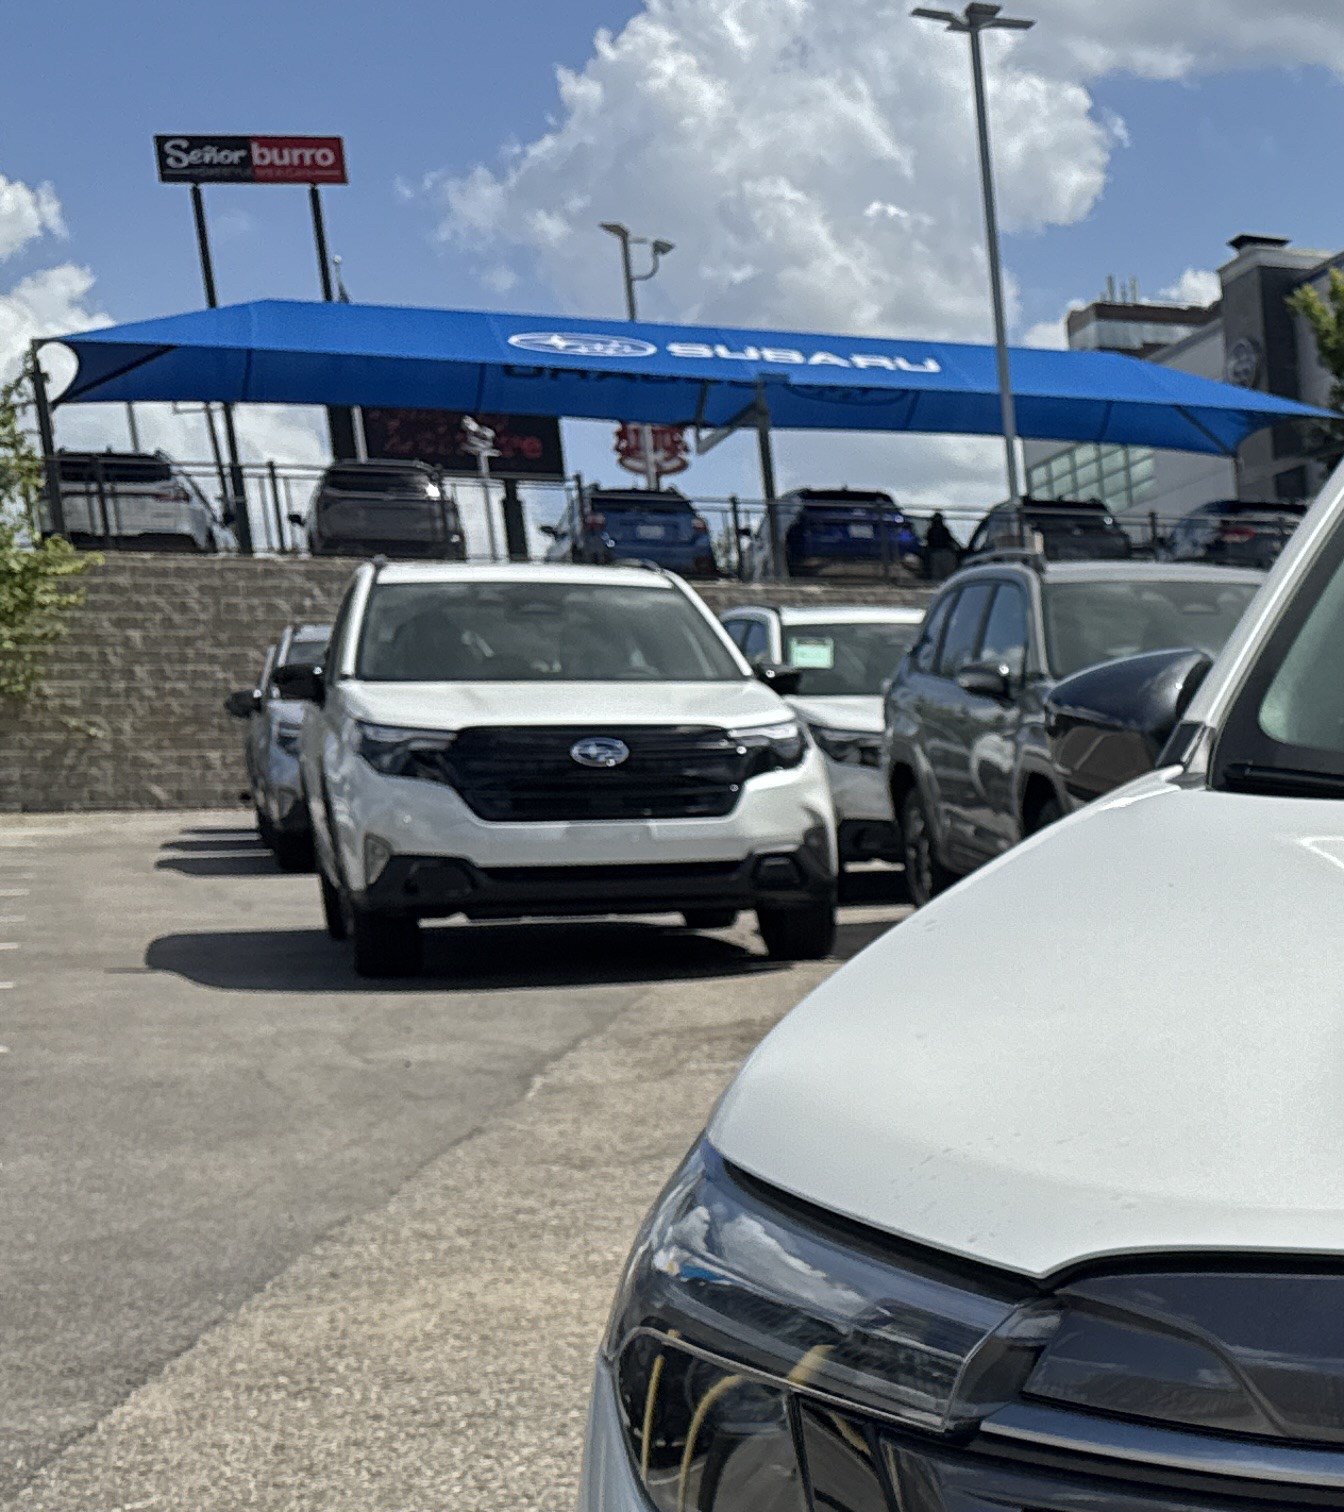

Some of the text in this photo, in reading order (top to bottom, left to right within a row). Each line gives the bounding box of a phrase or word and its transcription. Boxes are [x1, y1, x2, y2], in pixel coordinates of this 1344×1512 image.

[163, 137, 336, 169] Señor burro
[665, 341, 942, 374] SUBARU
